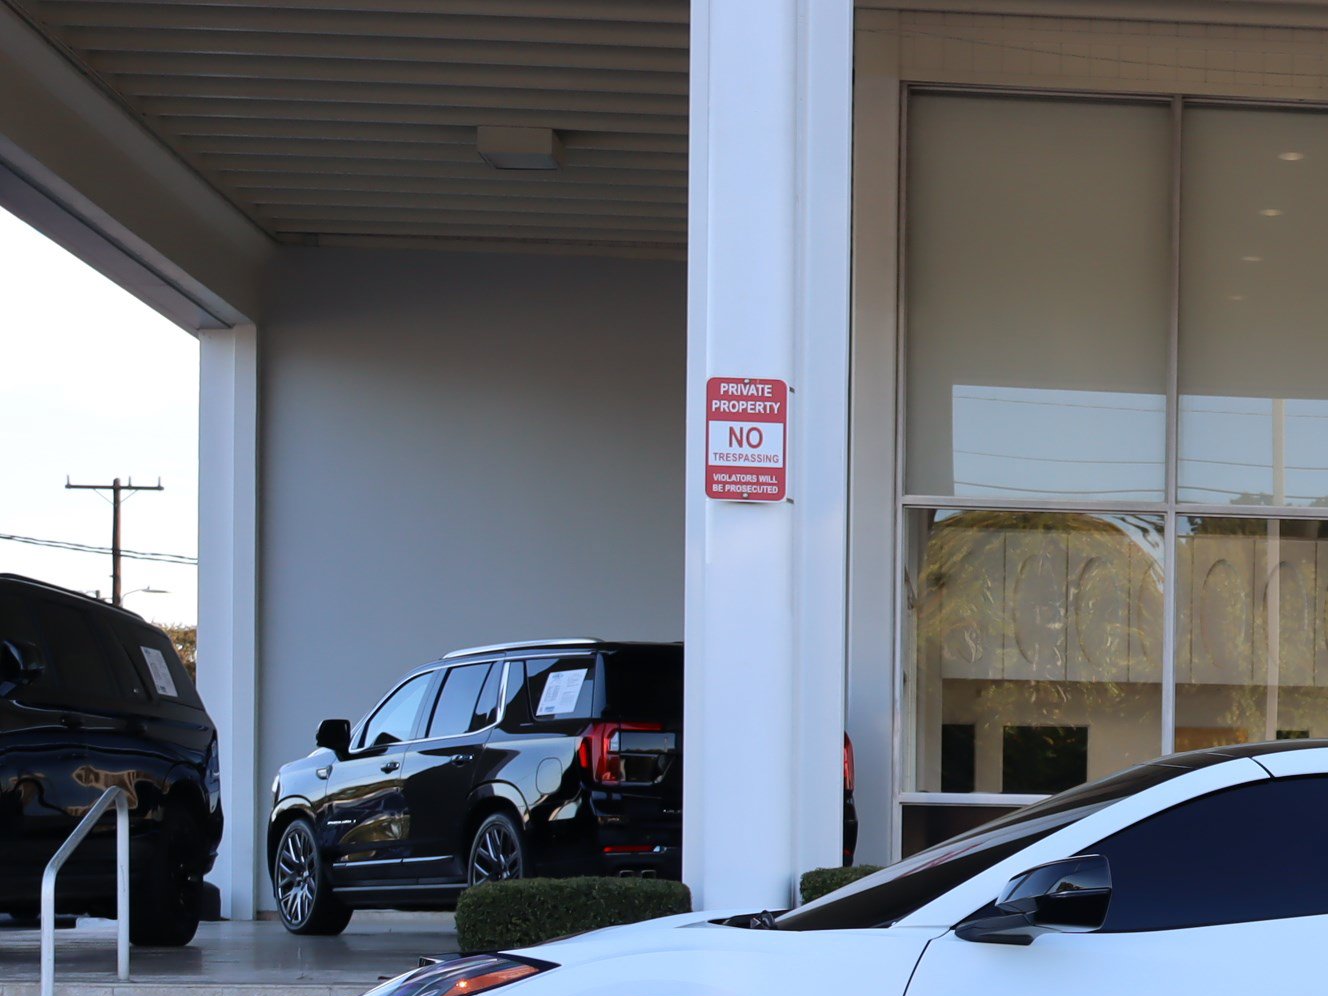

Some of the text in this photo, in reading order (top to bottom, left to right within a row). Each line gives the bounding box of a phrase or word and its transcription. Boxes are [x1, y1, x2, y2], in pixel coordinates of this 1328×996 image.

[720, 383, 772, 397] PRIVATE
[711, 399, 780, 414] PROPERTY
[728, 426, 763, 449] NO
[713, 452, 779, 463] TRESPASSING
[713, 473, 778, 483] VIOLATORS WILL
[712, 483, 778, 494] BE PROSECUTED
